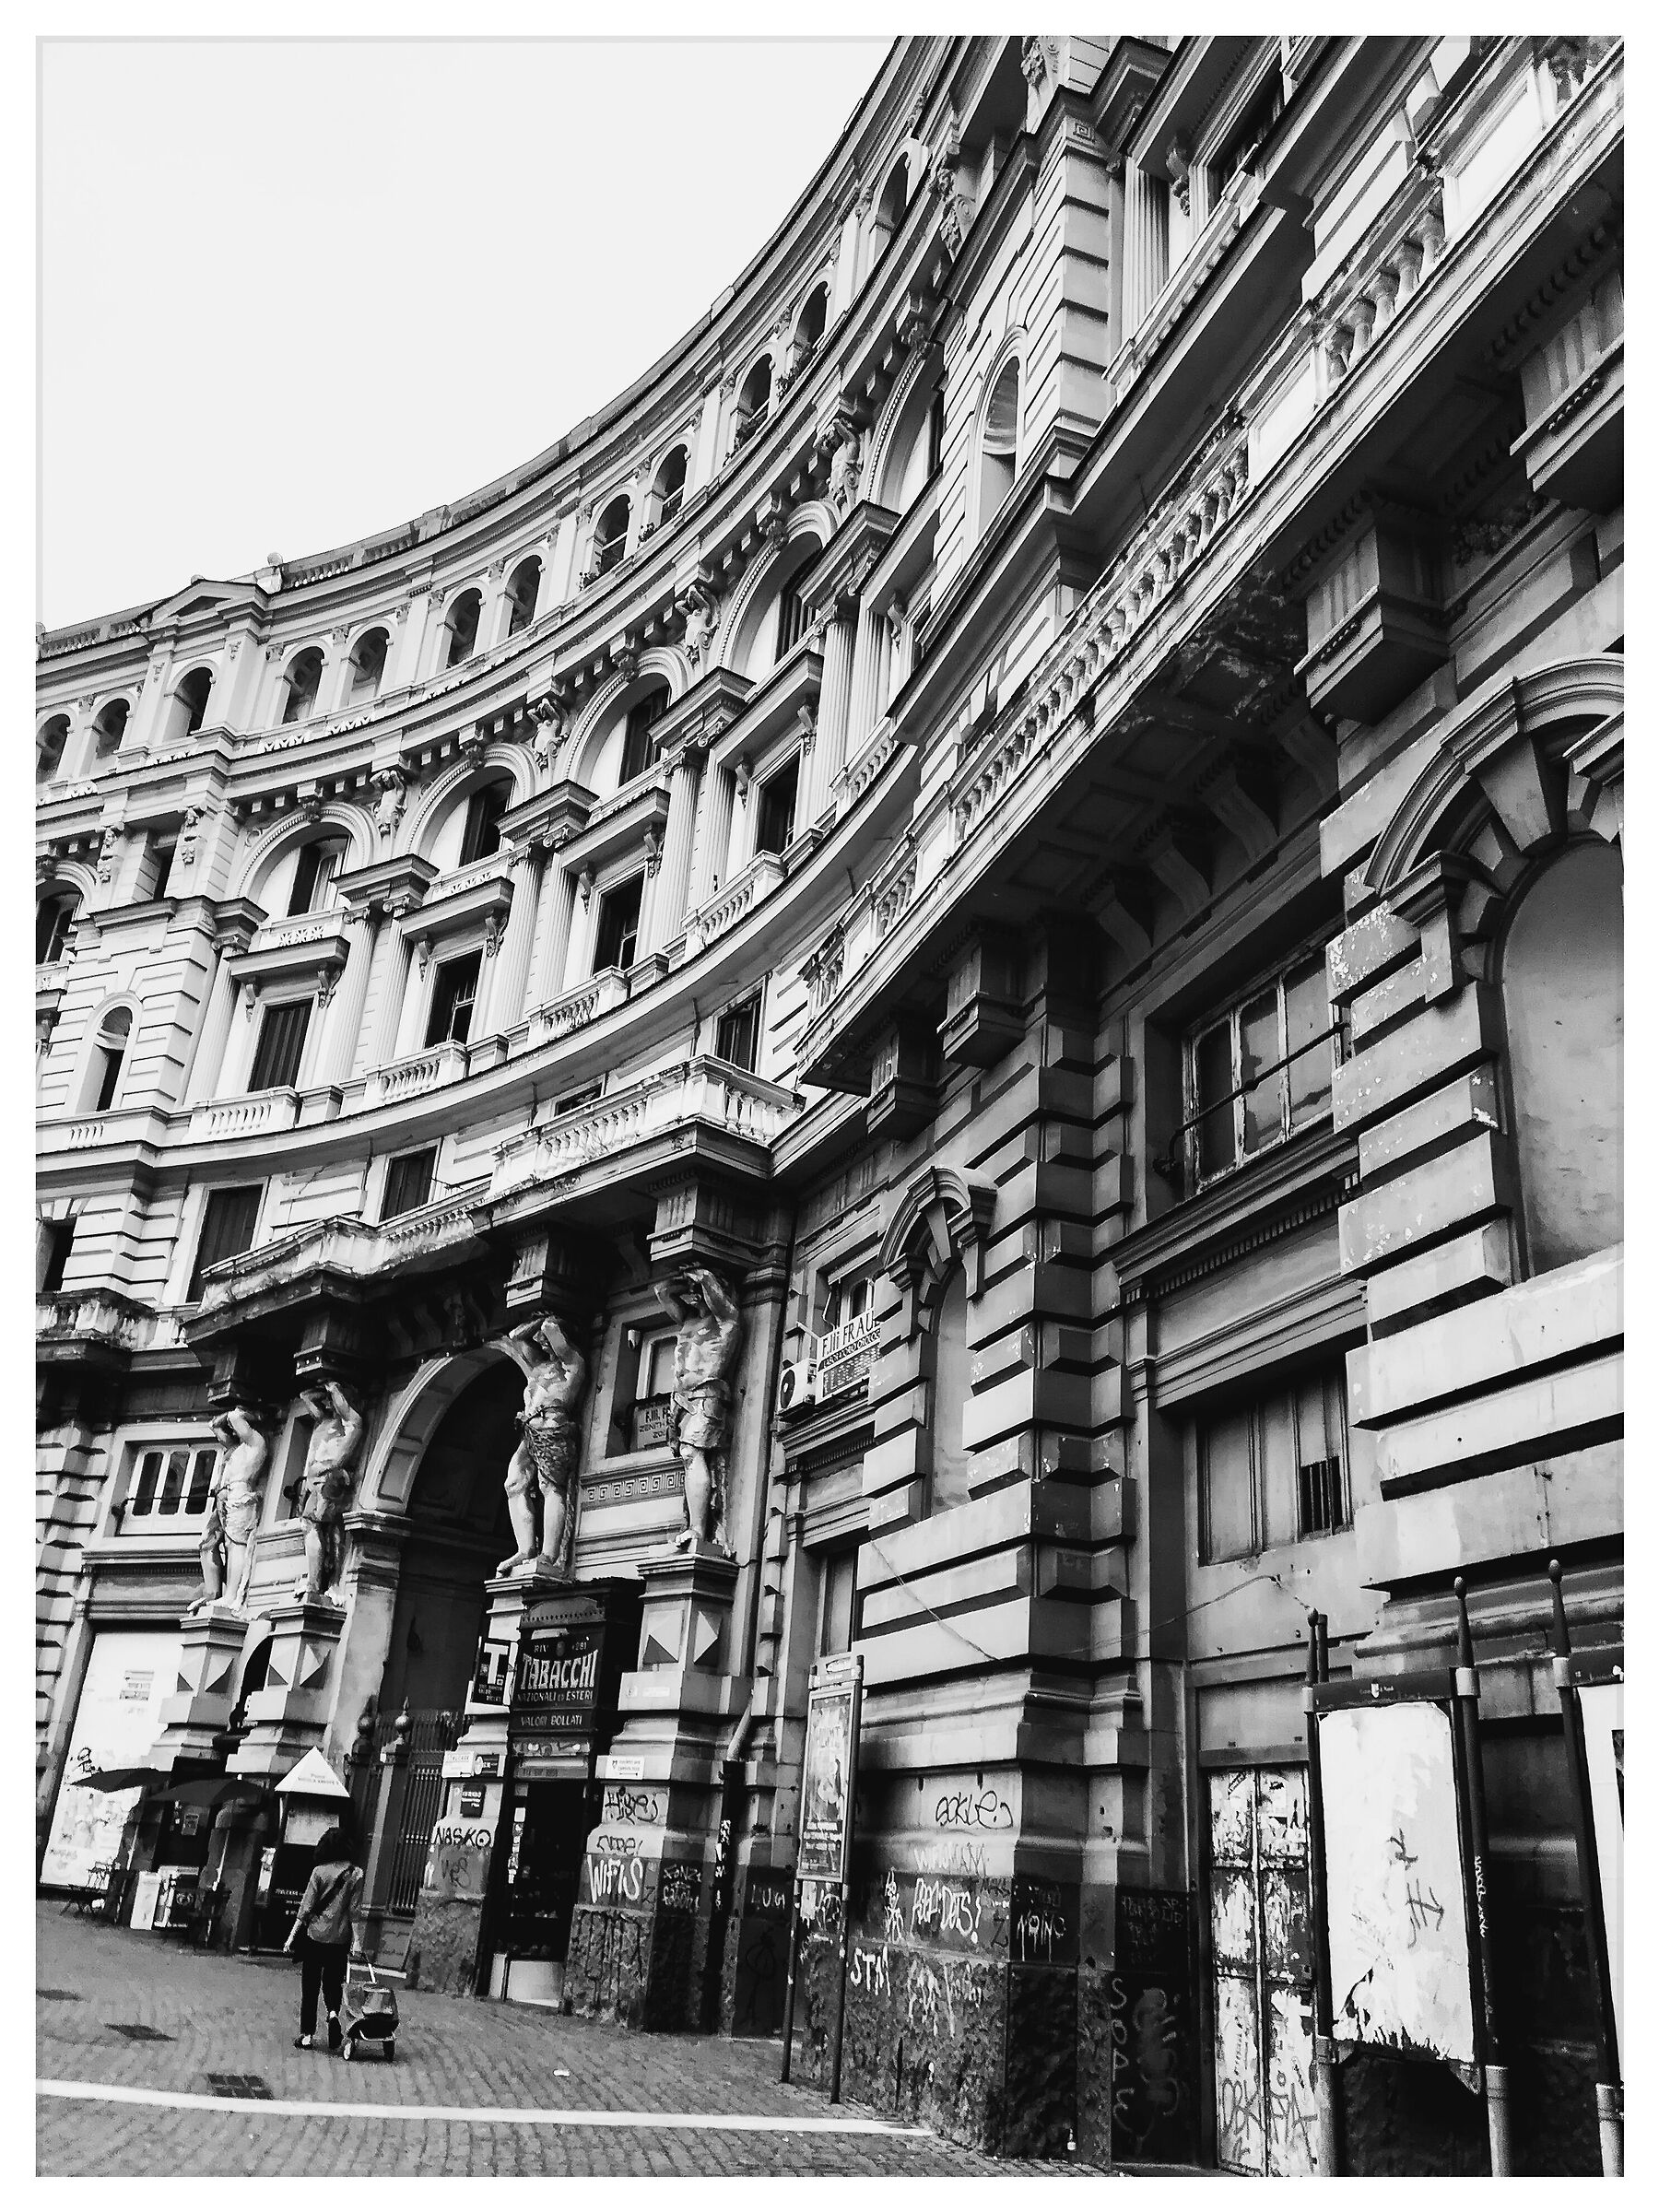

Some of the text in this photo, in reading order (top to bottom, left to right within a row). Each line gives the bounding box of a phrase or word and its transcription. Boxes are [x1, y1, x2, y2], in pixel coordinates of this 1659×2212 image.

[484, 1642, 509, 1685] T
[520, 1648, 599, 1690] TABACCHI
[566, 1689, 594, 1701] ESTERI
[520, 1714, 582, 1726] VALORI BOLLATI
